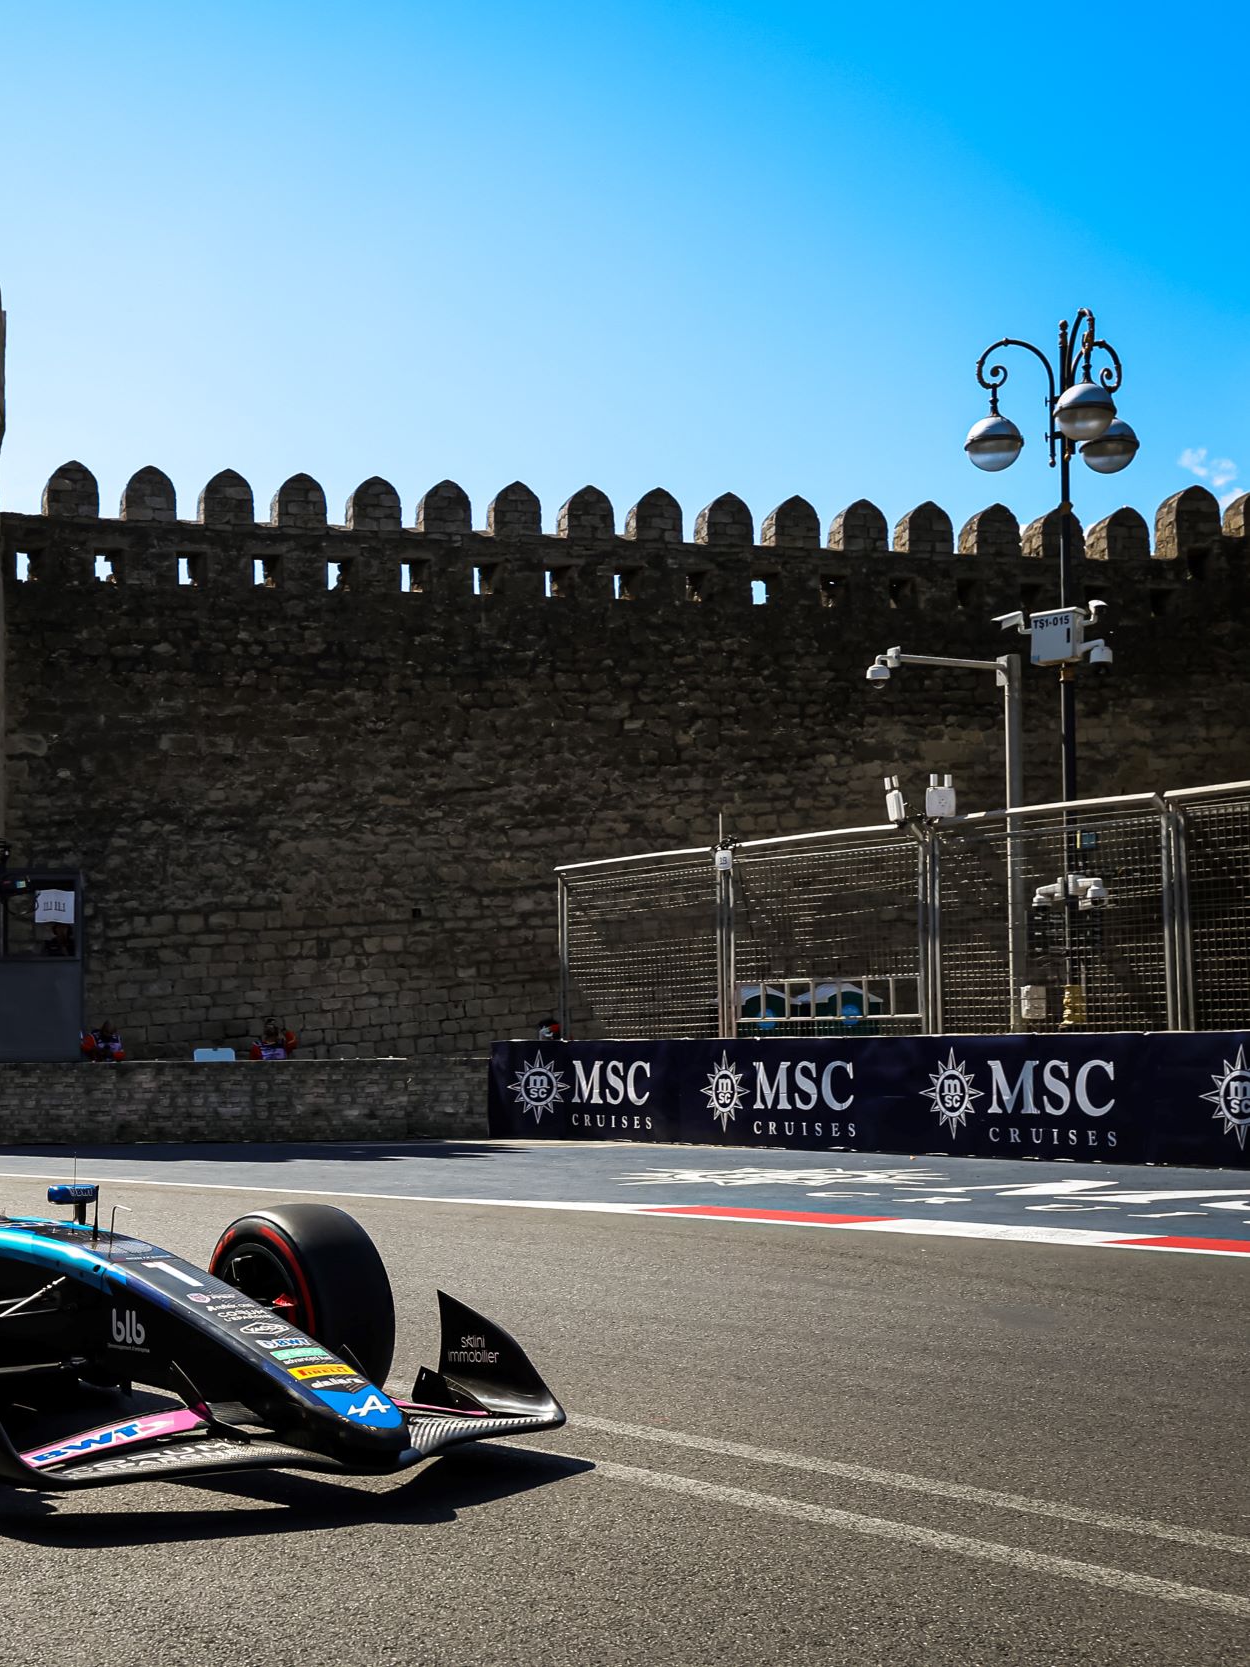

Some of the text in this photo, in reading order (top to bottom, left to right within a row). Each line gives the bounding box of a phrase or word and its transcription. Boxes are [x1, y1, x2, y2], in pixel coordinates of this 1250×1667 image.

[571, 1060, 650, 1106] MSC
[752, 1061, 854, 1111] MSC
[987, 1059, 1115, 1116] MSC
[572, 1114, 652, 1130] CRUISES
[753, 1121, 856, 1137] CRUISES
[989, 1127, 1117, 1147] CRUISES
[141, 1261, 204, 1287] 1
[112, 1308, 145, 1345] blb
[275, 1337, 311, 1347] BWT
[448, 1350, 500, 1364] immobilier
[297, 1366, 349, 1377] PIRELLI
[32, 1423, 141, 1462] BWT
